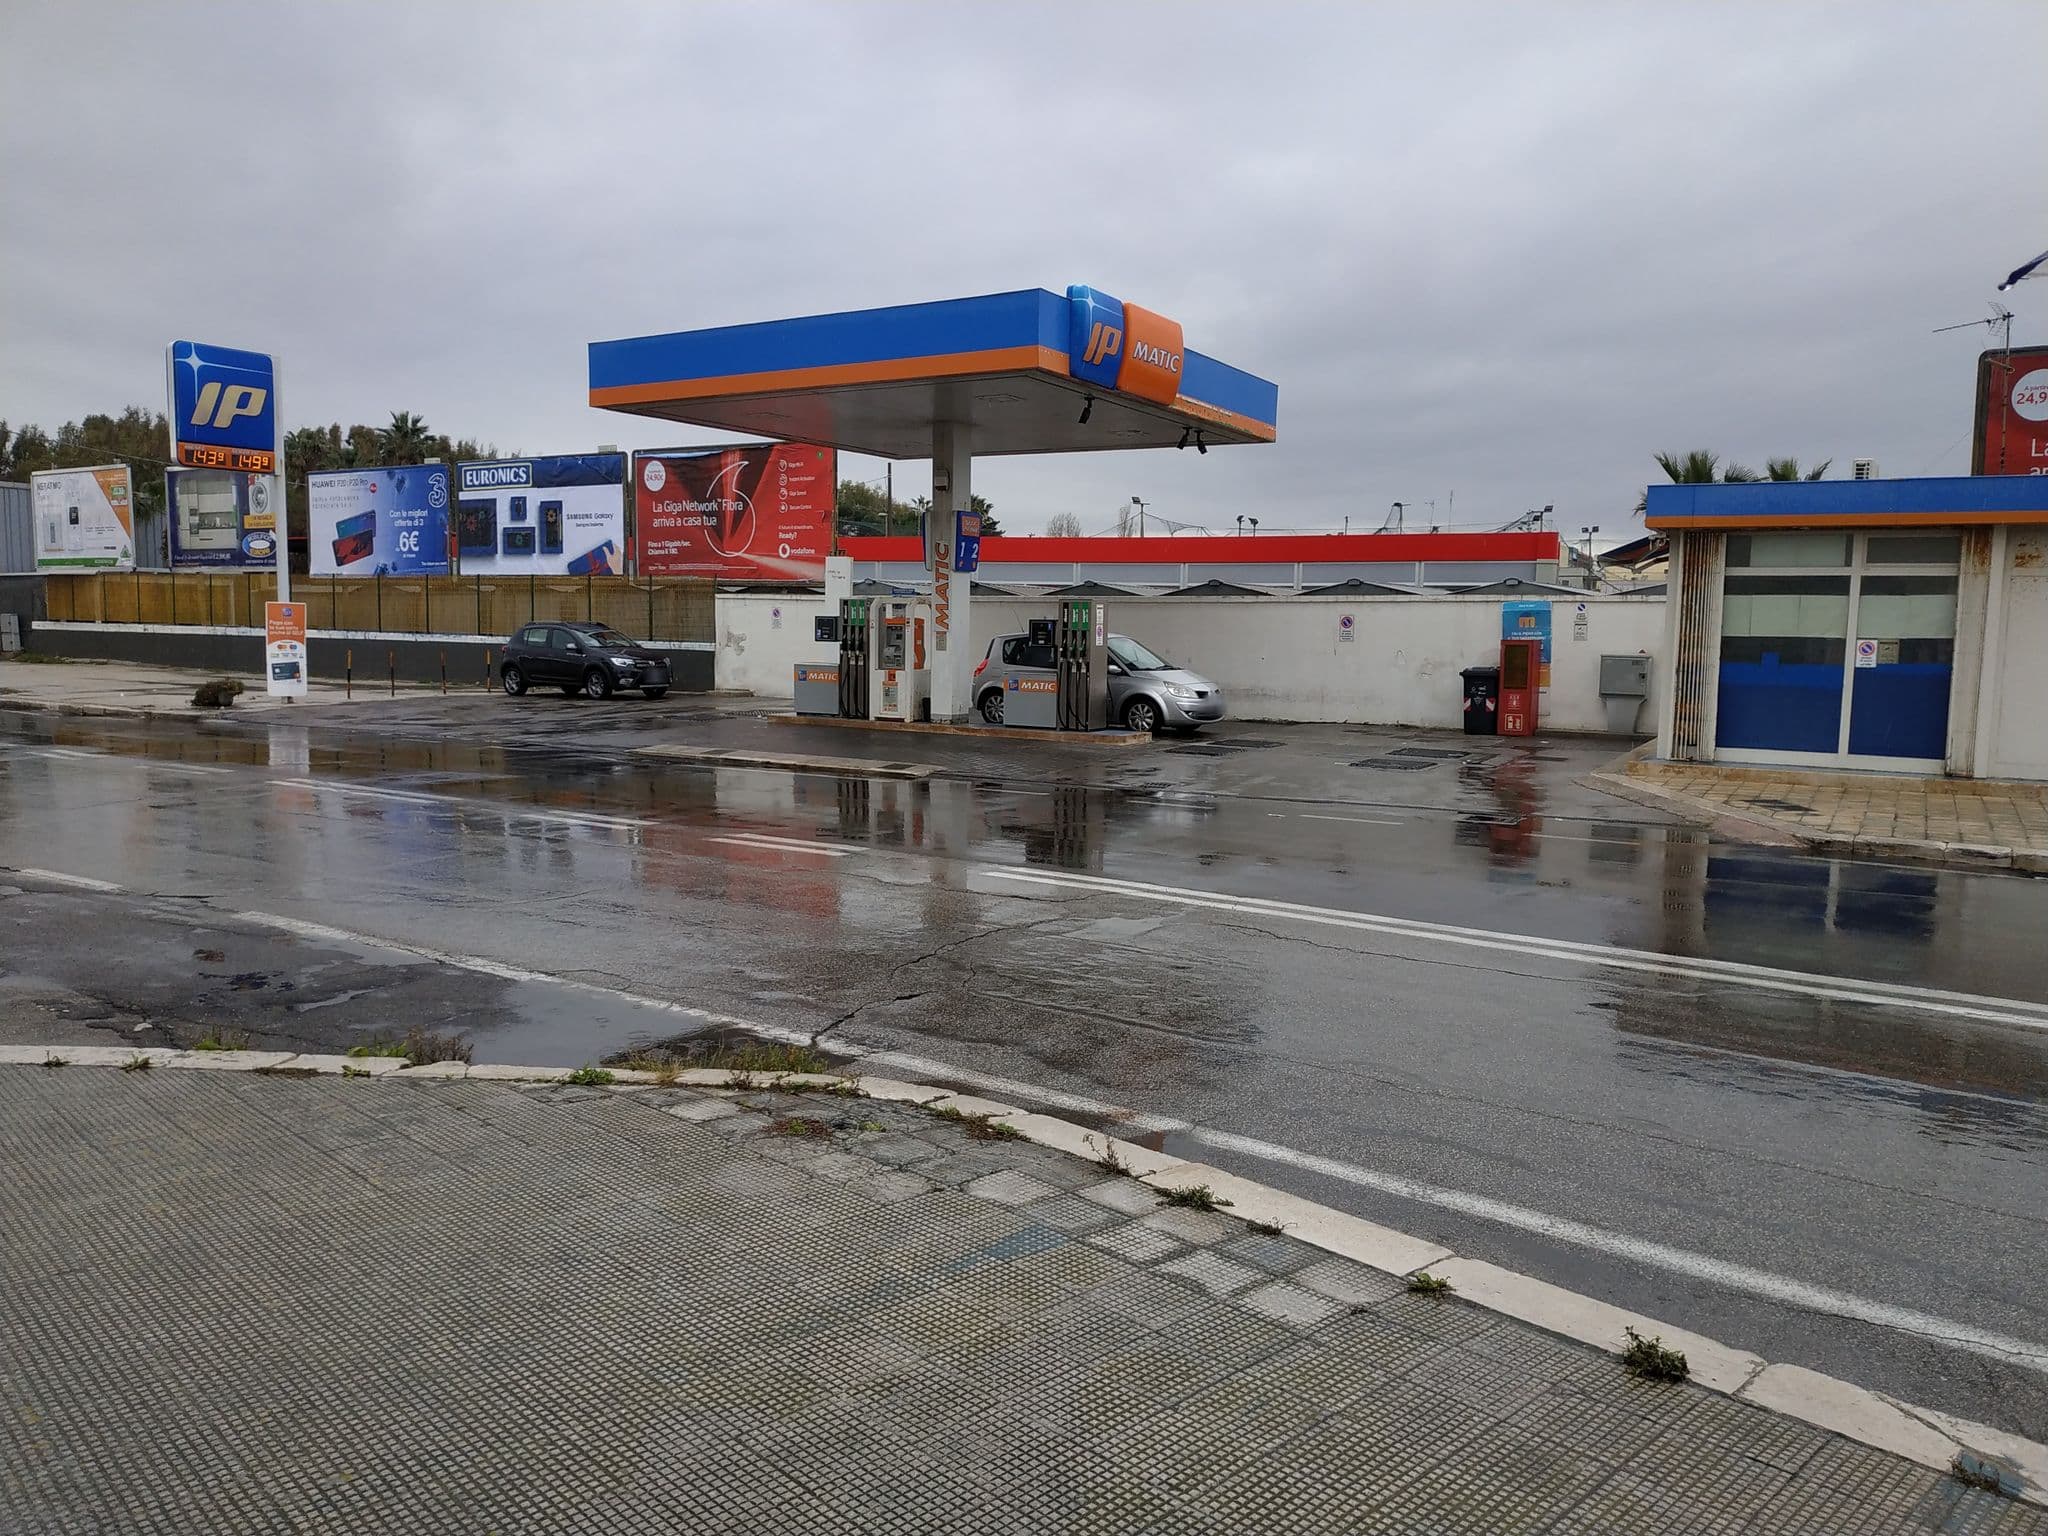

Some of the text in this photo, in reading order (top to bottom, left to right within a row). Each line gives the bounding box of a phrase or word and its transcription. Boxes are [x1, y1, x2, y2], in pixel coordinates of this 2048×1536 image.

[1083, 322, 1122, 366] IP
[1133, 341, 1180, 373] MATIC
[190, 382, 267, 428] IP
[466, 467, 527, 486] EURONICS
[312, 480, 336, 488] HUAWEI
[652, 501, 662, 512] La
[722, 499, 743, 511] Fibra
[566, 512, 614, 520] SAMSUNG Galaxy
[653, 515, 717, 527] arriva a casa tua
[400, 530, 419, 551] 6€
[779, 532, 798, 540] Ready?
[790, 547, 815, 555] vodafone
[960, 542, 979, 559] 1 2
[935, 542, 949, 630] MATIC
[809, 672, 838, 680] MATIC
[1021, 682, 1056, 691] MATIC
